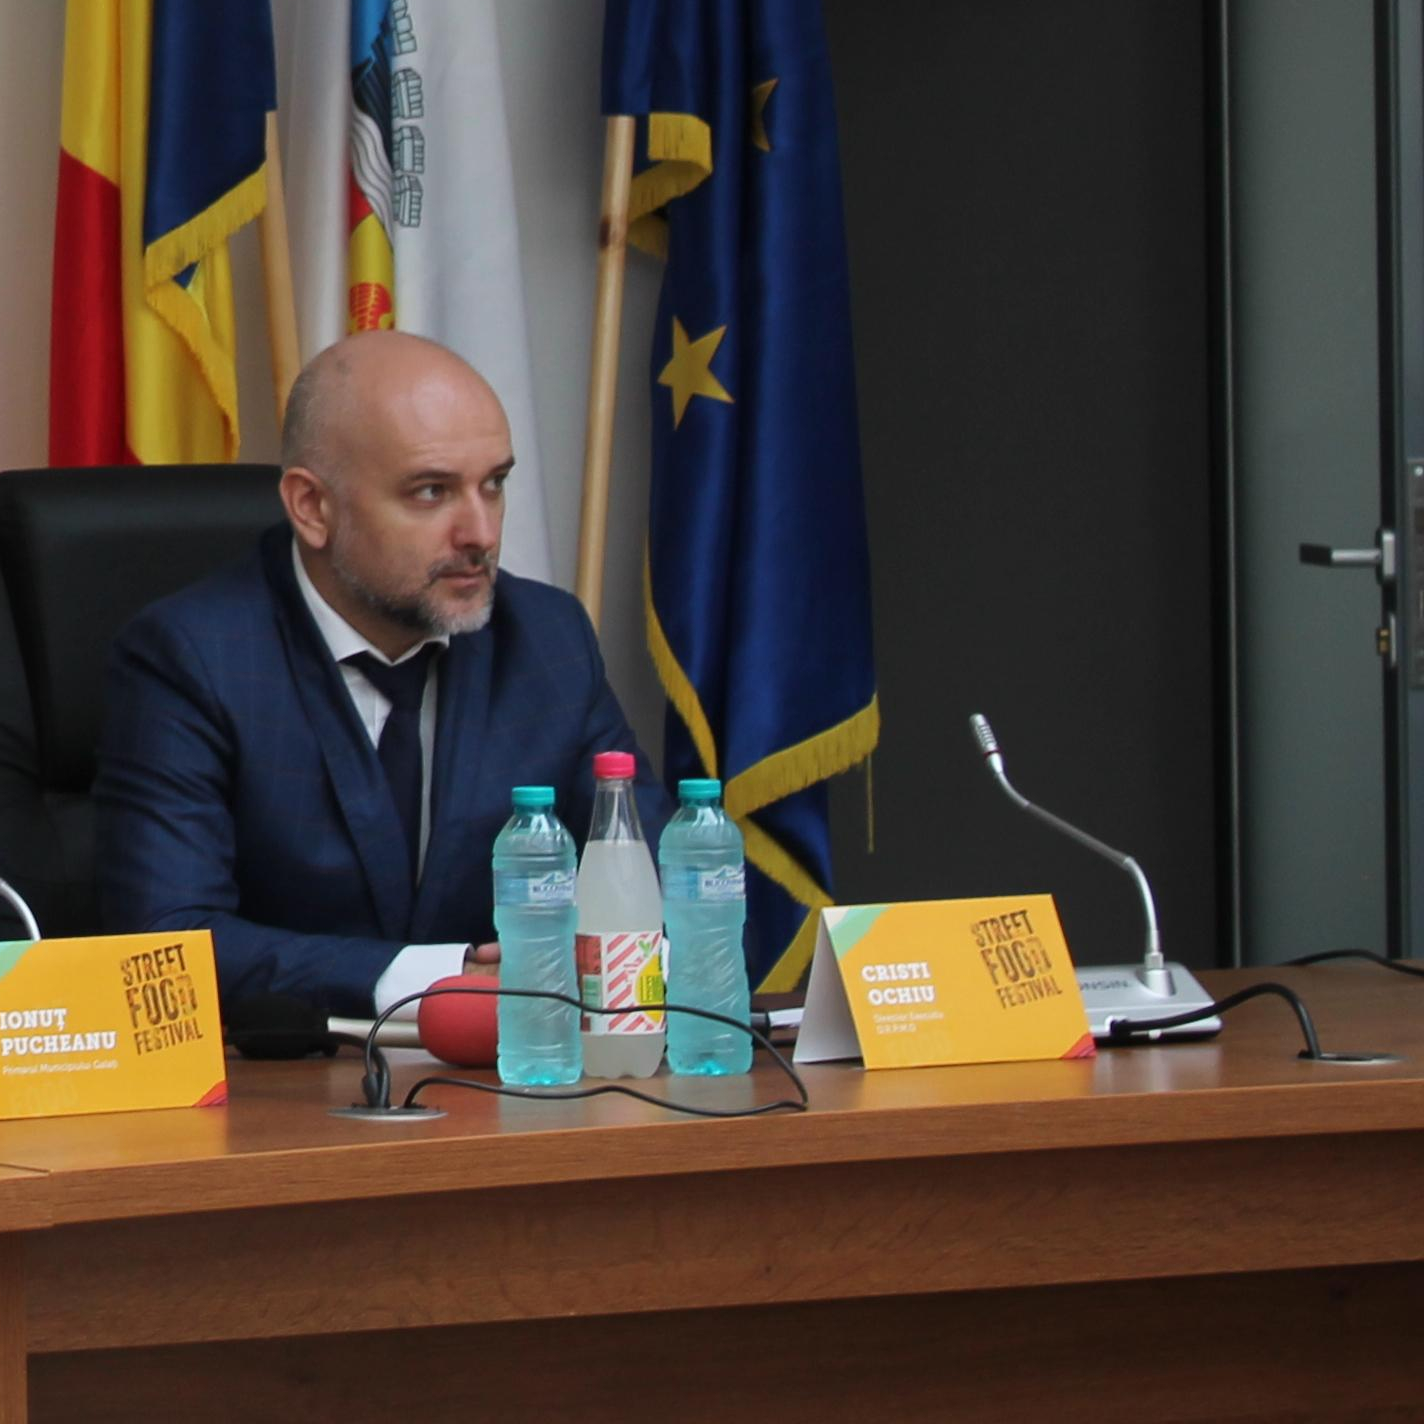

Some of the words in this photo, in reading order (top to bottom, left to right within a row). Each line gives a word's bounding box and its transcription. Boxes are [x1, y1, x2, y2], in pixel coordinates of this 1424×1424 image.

[861, 961, 932, 983] CRISTI
[868, 984, 936, 1006] OCHIU
[0, 1030, 118, 1057] PUCHEANU
